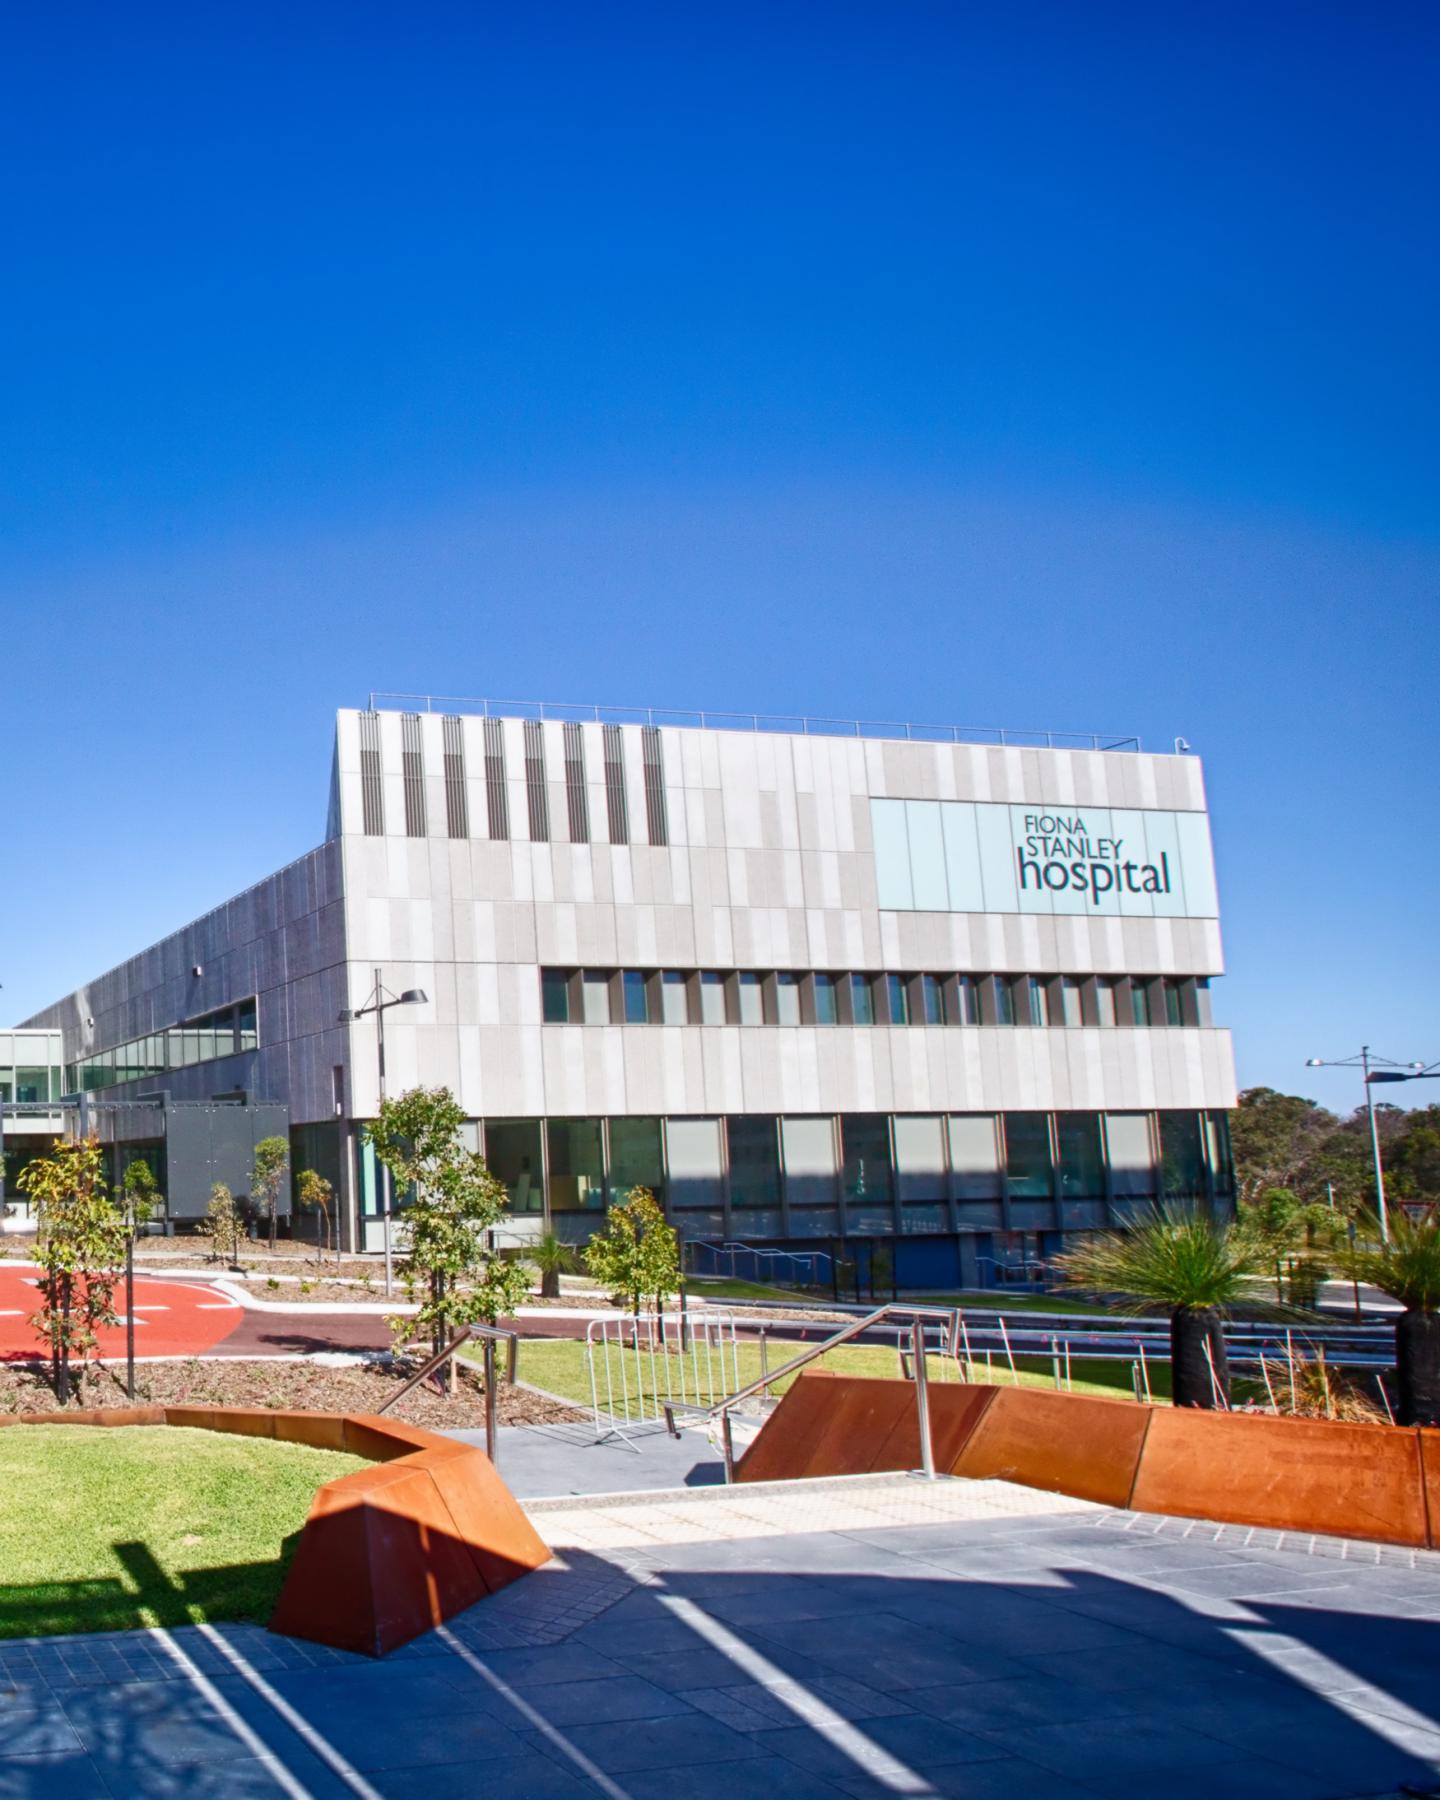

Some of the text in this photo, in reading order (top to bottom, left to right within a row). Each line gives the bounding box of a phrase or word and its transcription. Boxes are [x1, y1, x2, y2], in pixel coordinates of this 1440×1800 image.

[1024, 815, 1087, 836] FIONA
[1026, 836, 1123, 860] STANLEY
[1017, 846, 1171, 906] hospital
